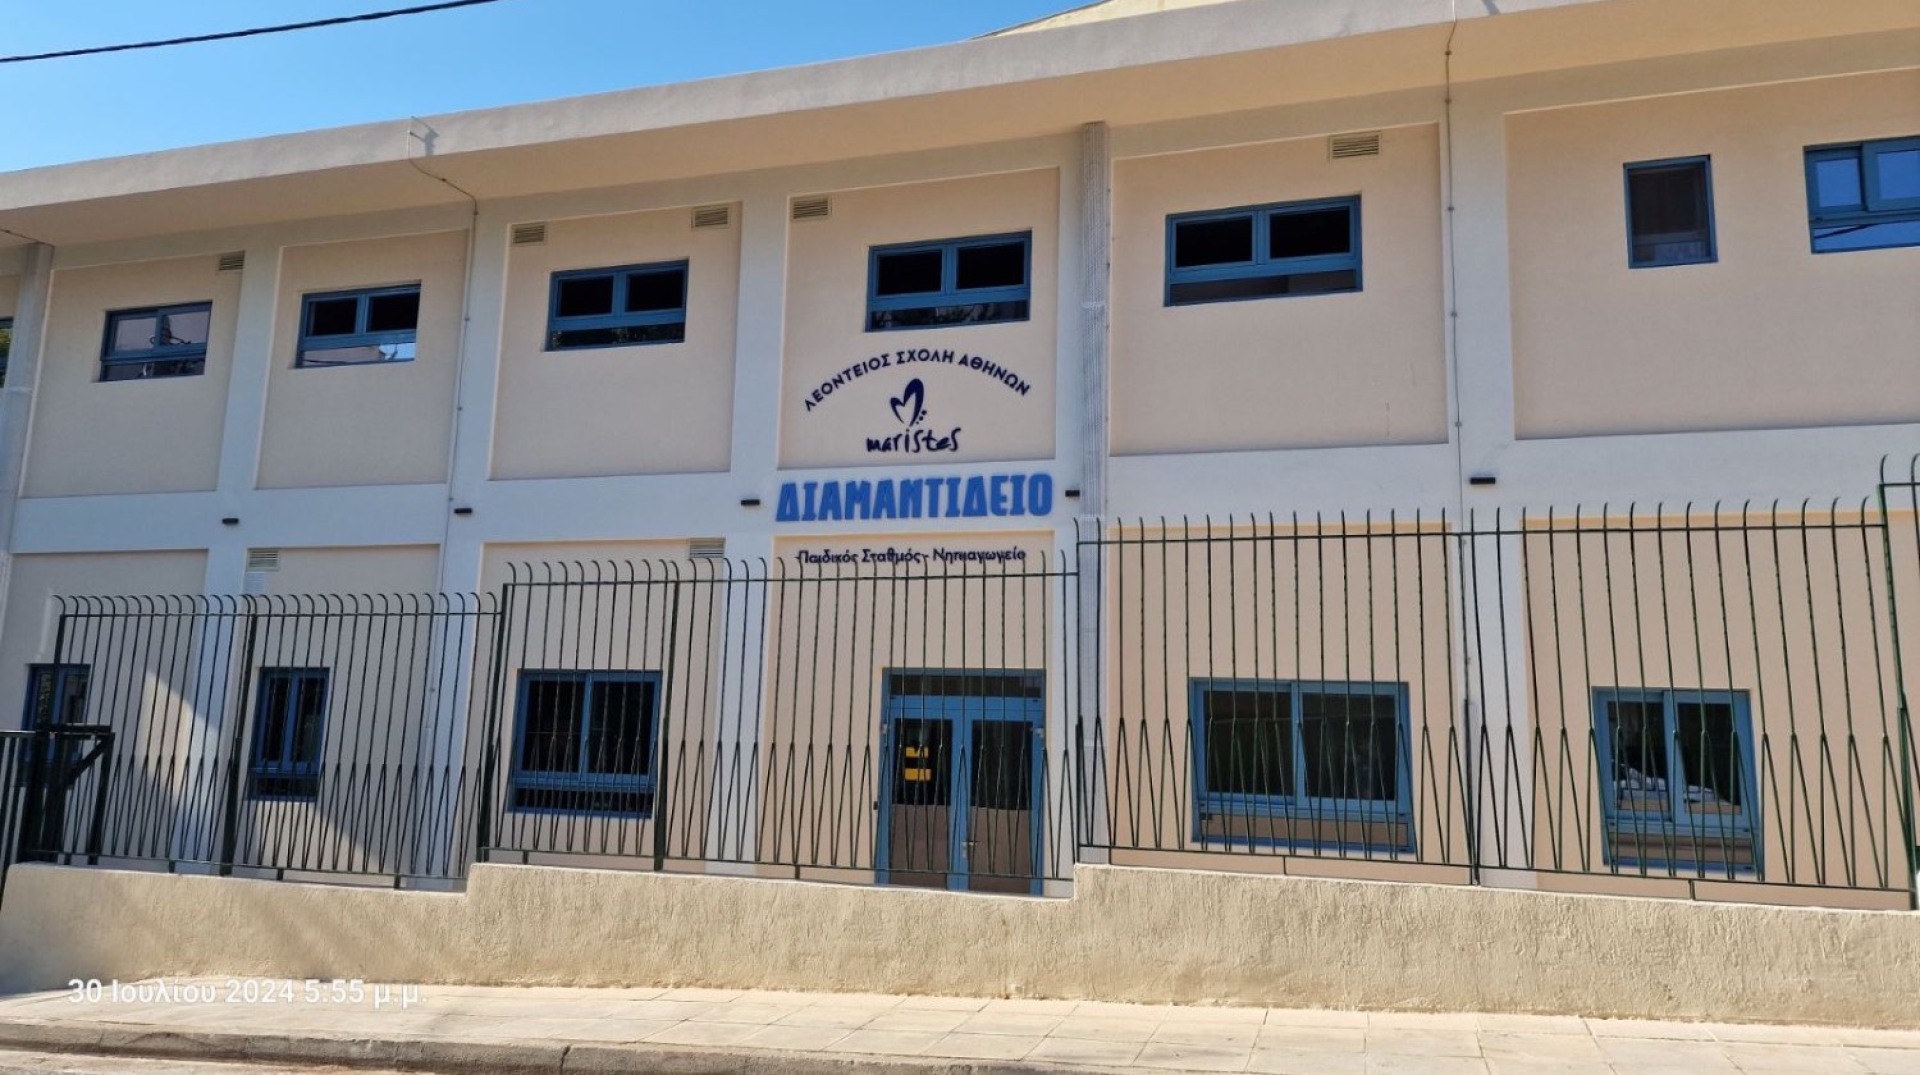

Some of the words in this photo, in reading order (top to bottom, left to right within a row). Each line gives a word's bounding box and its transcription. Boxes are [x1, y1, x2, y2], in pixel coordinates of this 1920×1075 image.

[804, 353, 891, 412] ΛΕΟΝΤΕΙΟΣ
[896, 348, 954, 366] ΣΧΟΛΗ
[958, 353, 1031, 396] ΑΘΗΝΩΝ
[775, 473, 1053, 522] ΔΙΑΜΑΝΤΙΔΕΙΟ
[861, 547, 920, 565] Σταθμός
